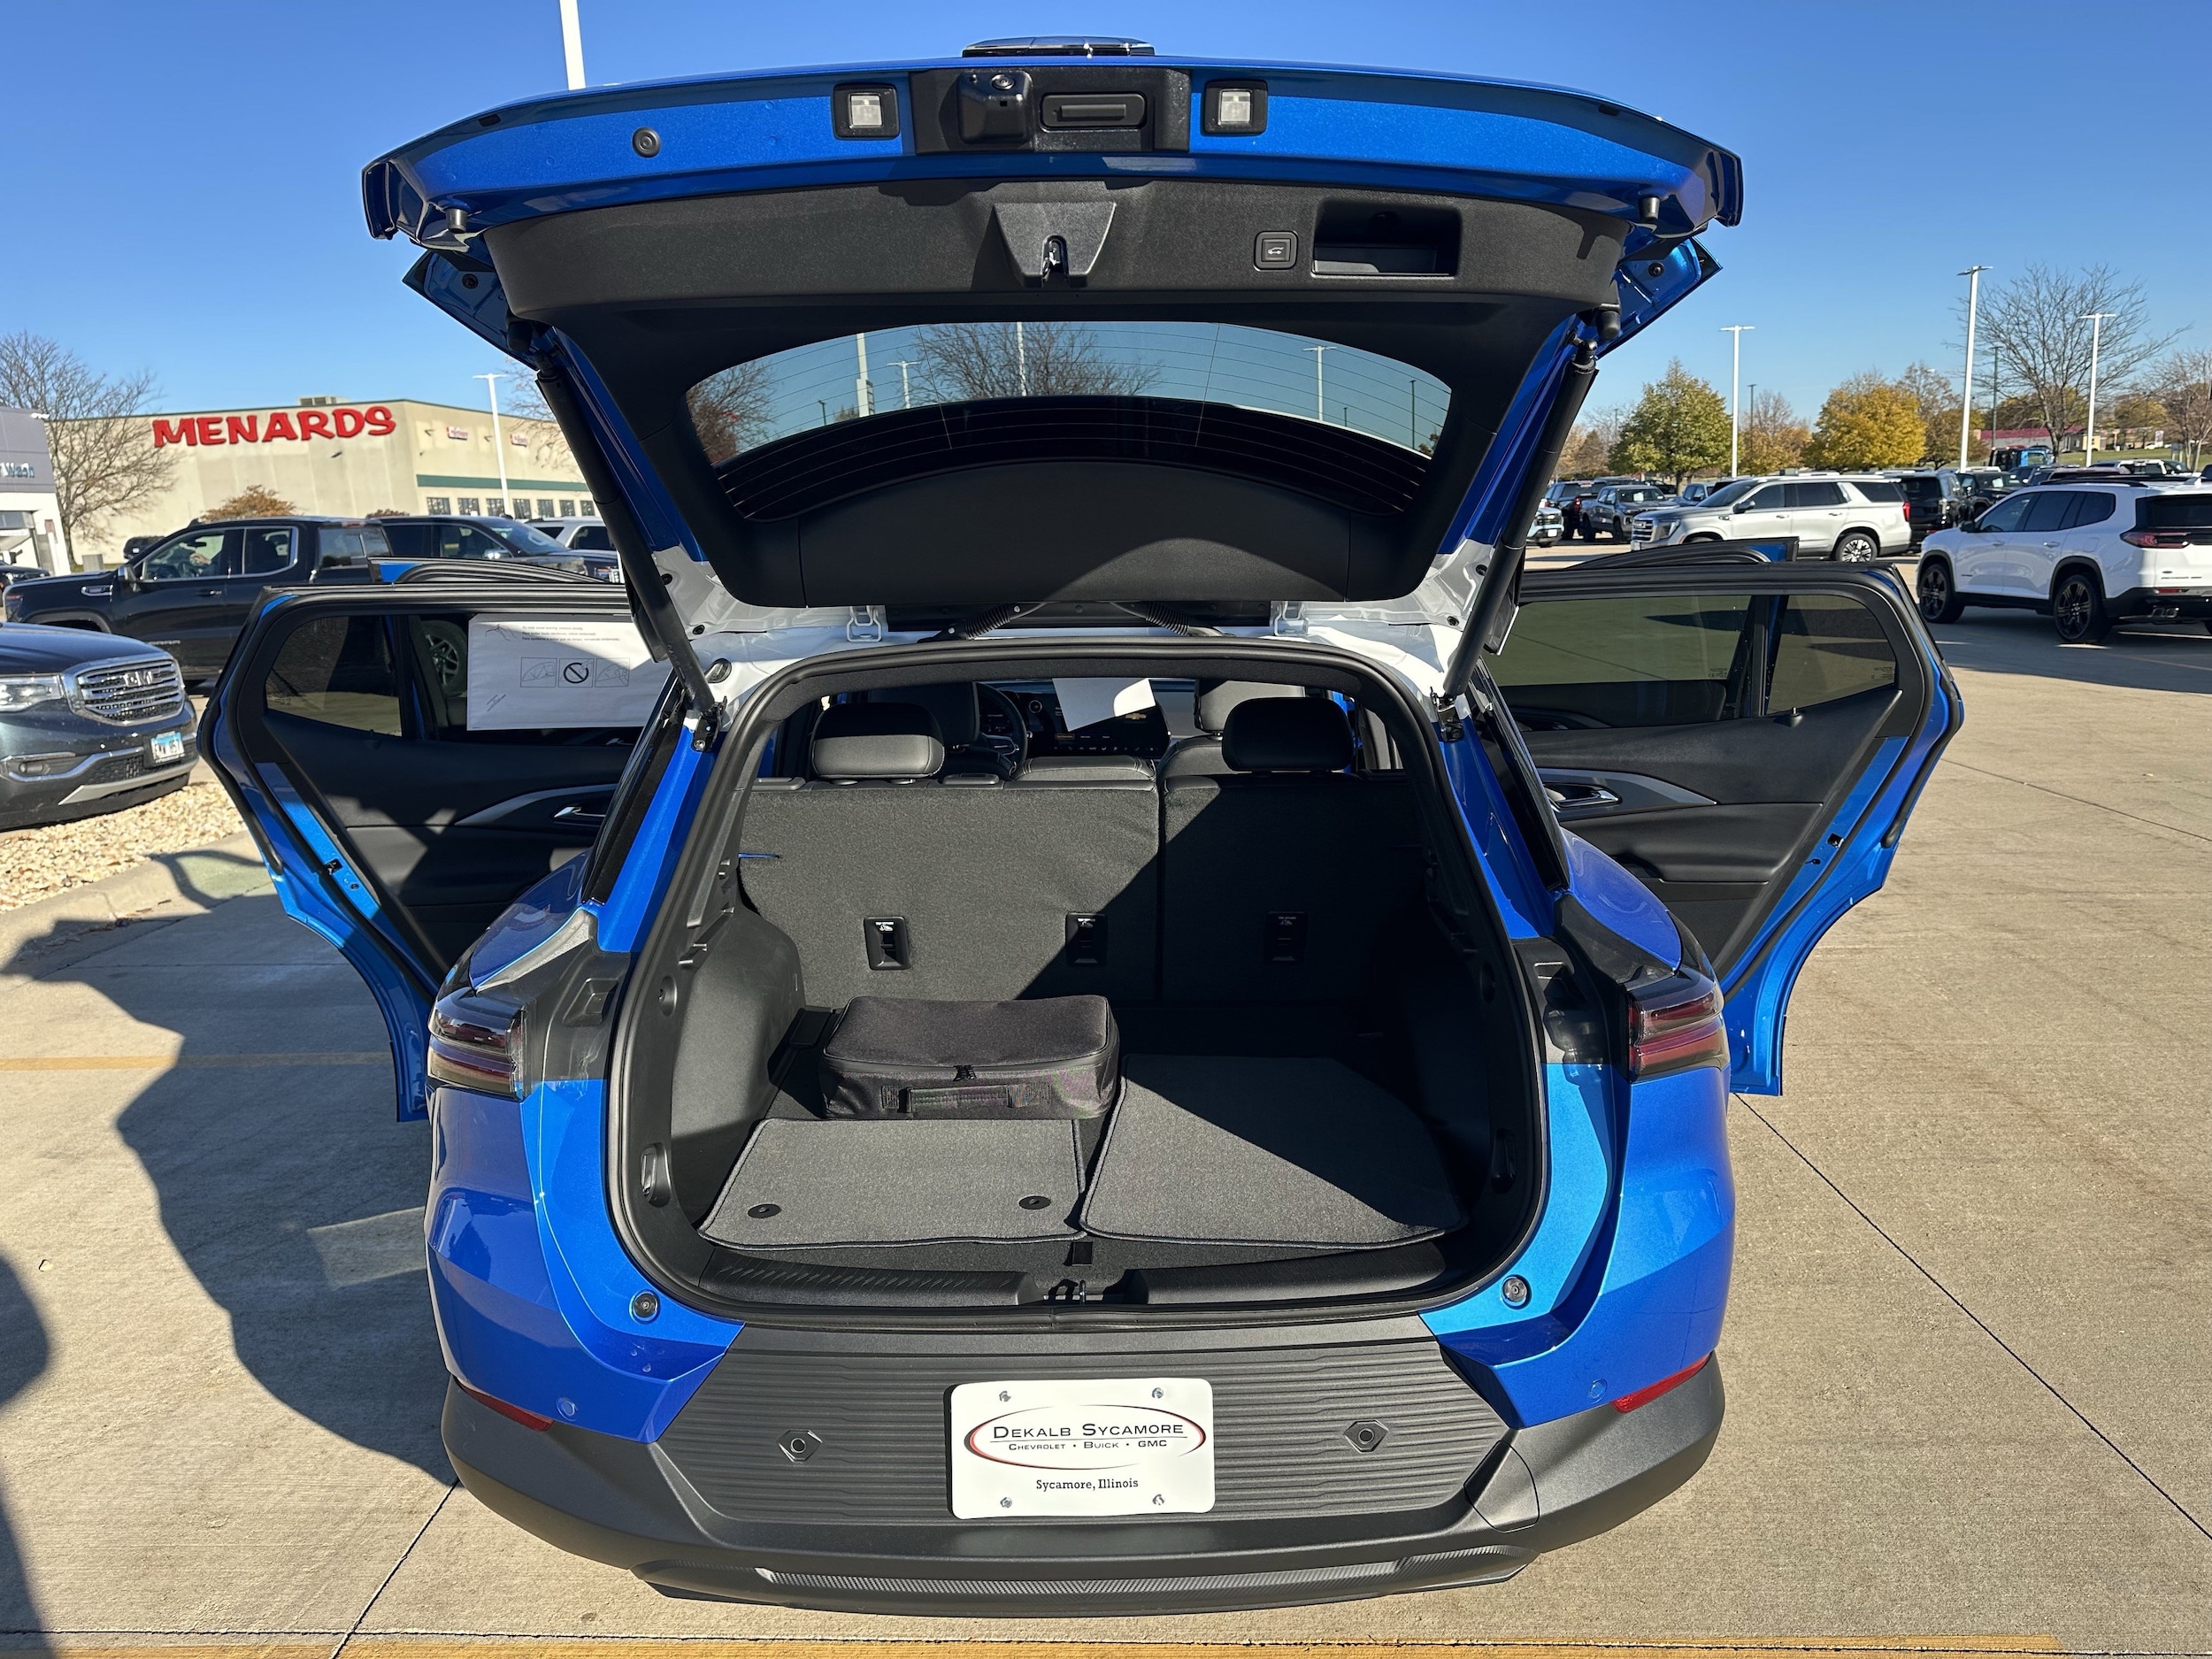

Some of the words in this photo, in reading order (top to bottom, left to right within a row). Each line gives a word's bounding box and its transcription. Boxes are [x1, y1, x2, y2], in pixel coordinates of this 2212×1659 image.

[152, 406, 396, 448] MENARDS
[1082, 1423, 1184, 1437] SYCAMORE
[1083, 1440, 1119, 1449] BUICK
[1035, 1479, 1096, 1493] Sycamore,
[1098, 1478, 1139, 1489] Illinois
